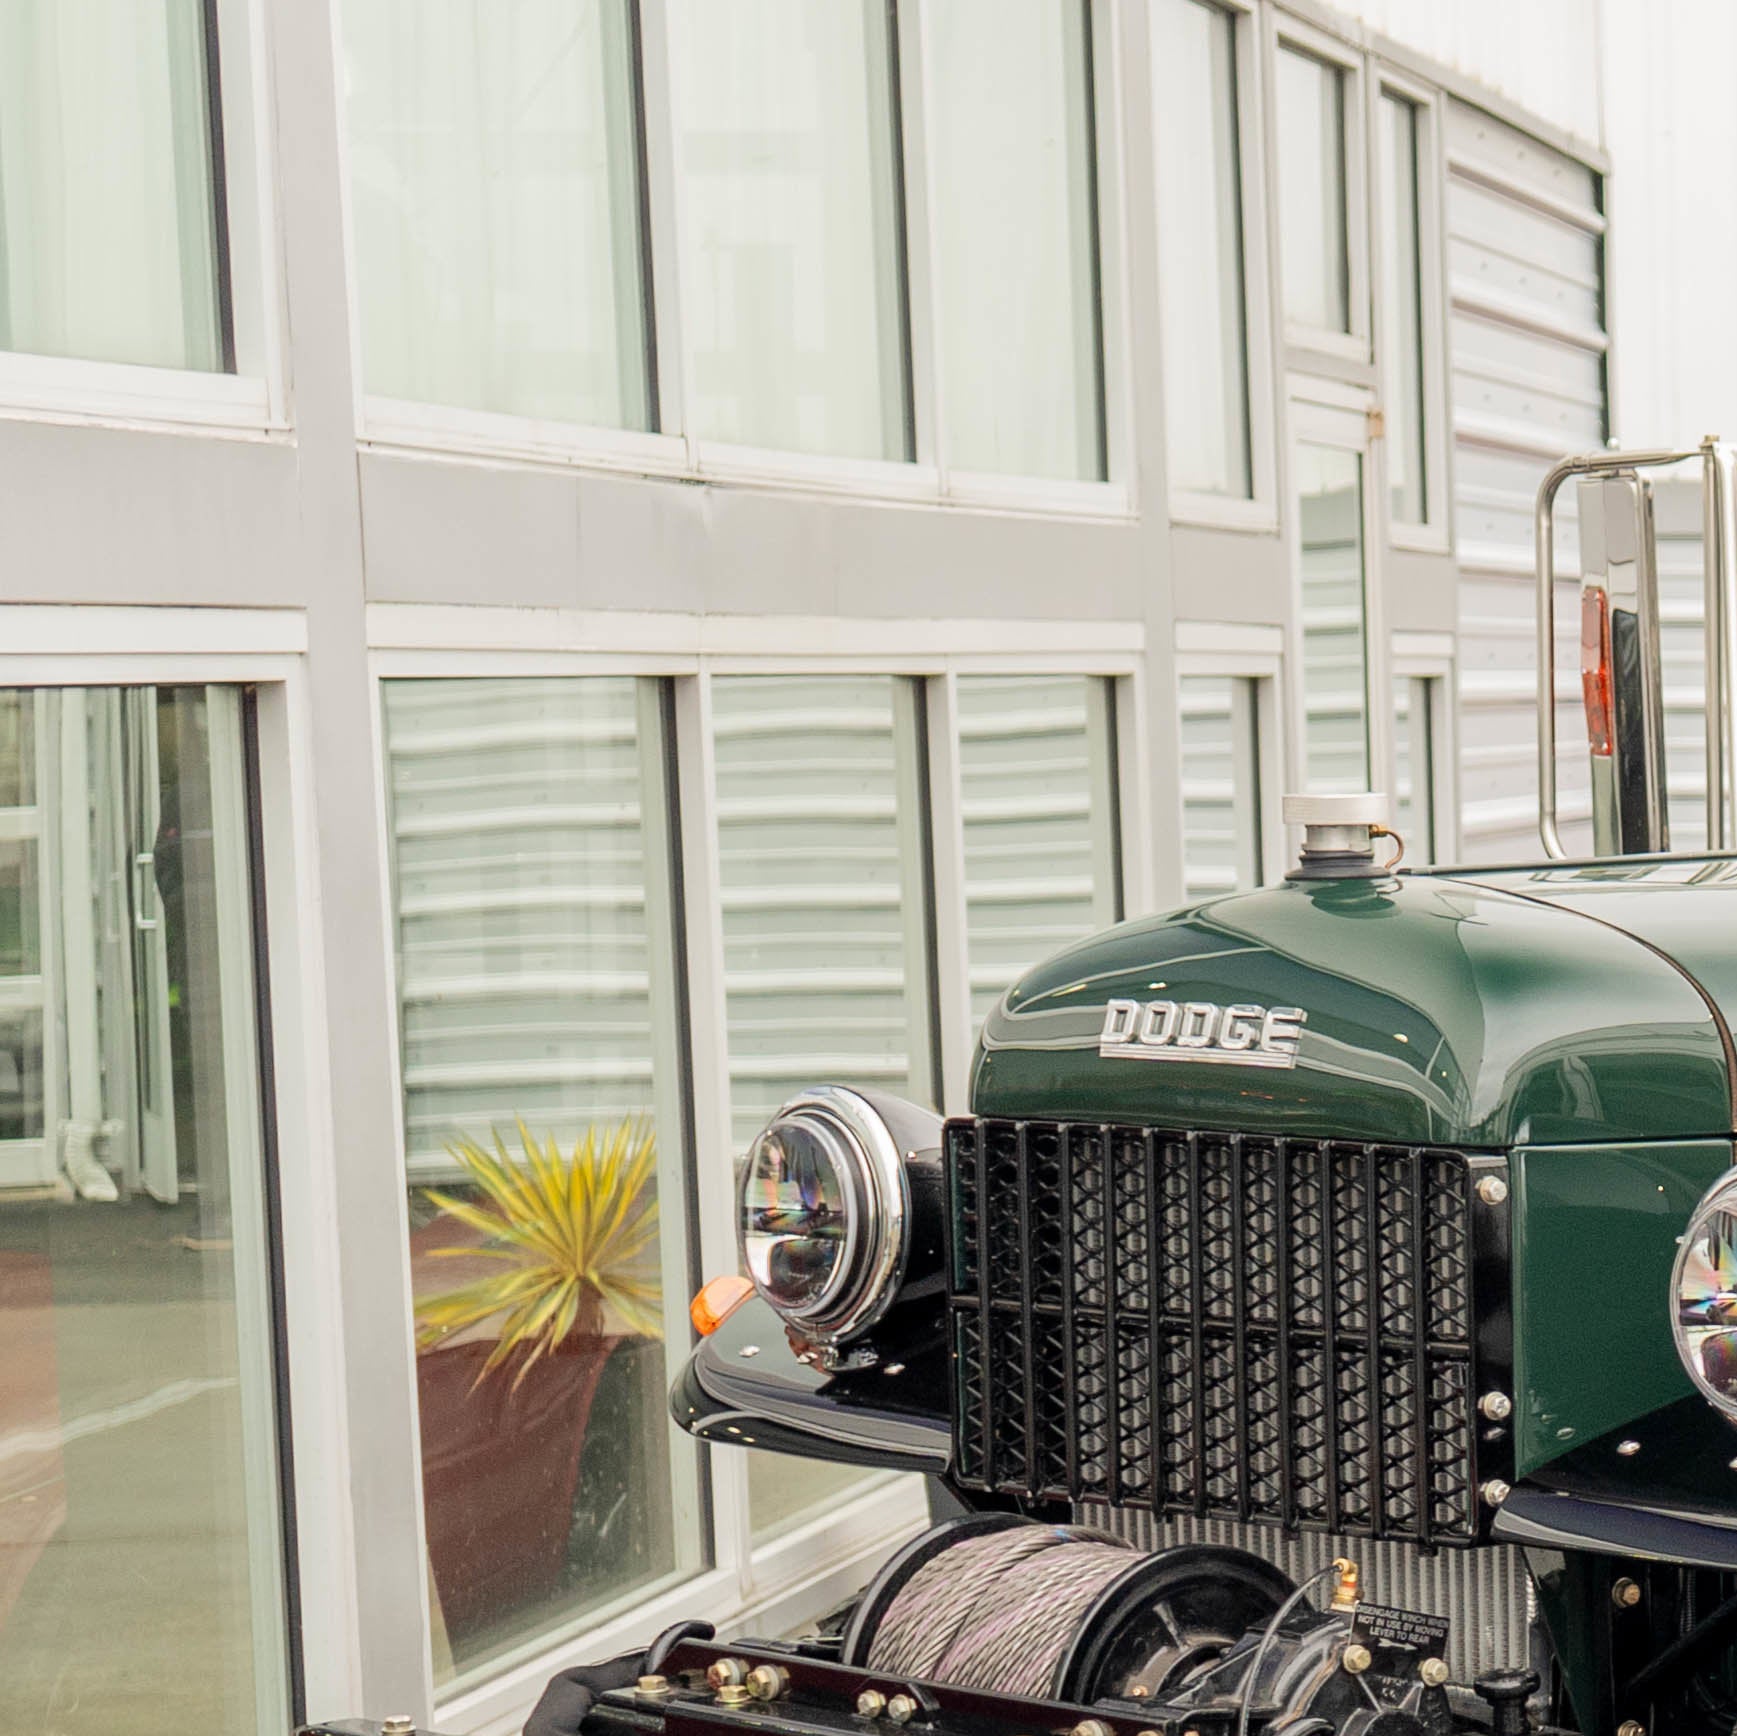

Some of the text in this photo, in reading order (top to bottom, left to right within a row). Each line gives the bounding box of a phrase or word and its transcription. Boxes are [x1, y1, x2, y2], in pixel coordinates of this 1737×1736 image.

[1100, 999, 1308, 1053] DODGE
[1357, 1614, 1444, 1638] NOT IN USE BY MOVING
[1401, 1611, 1426, 1625] WINCH
[1369, 1626, 1430, 1645] LEVER TO REAR
